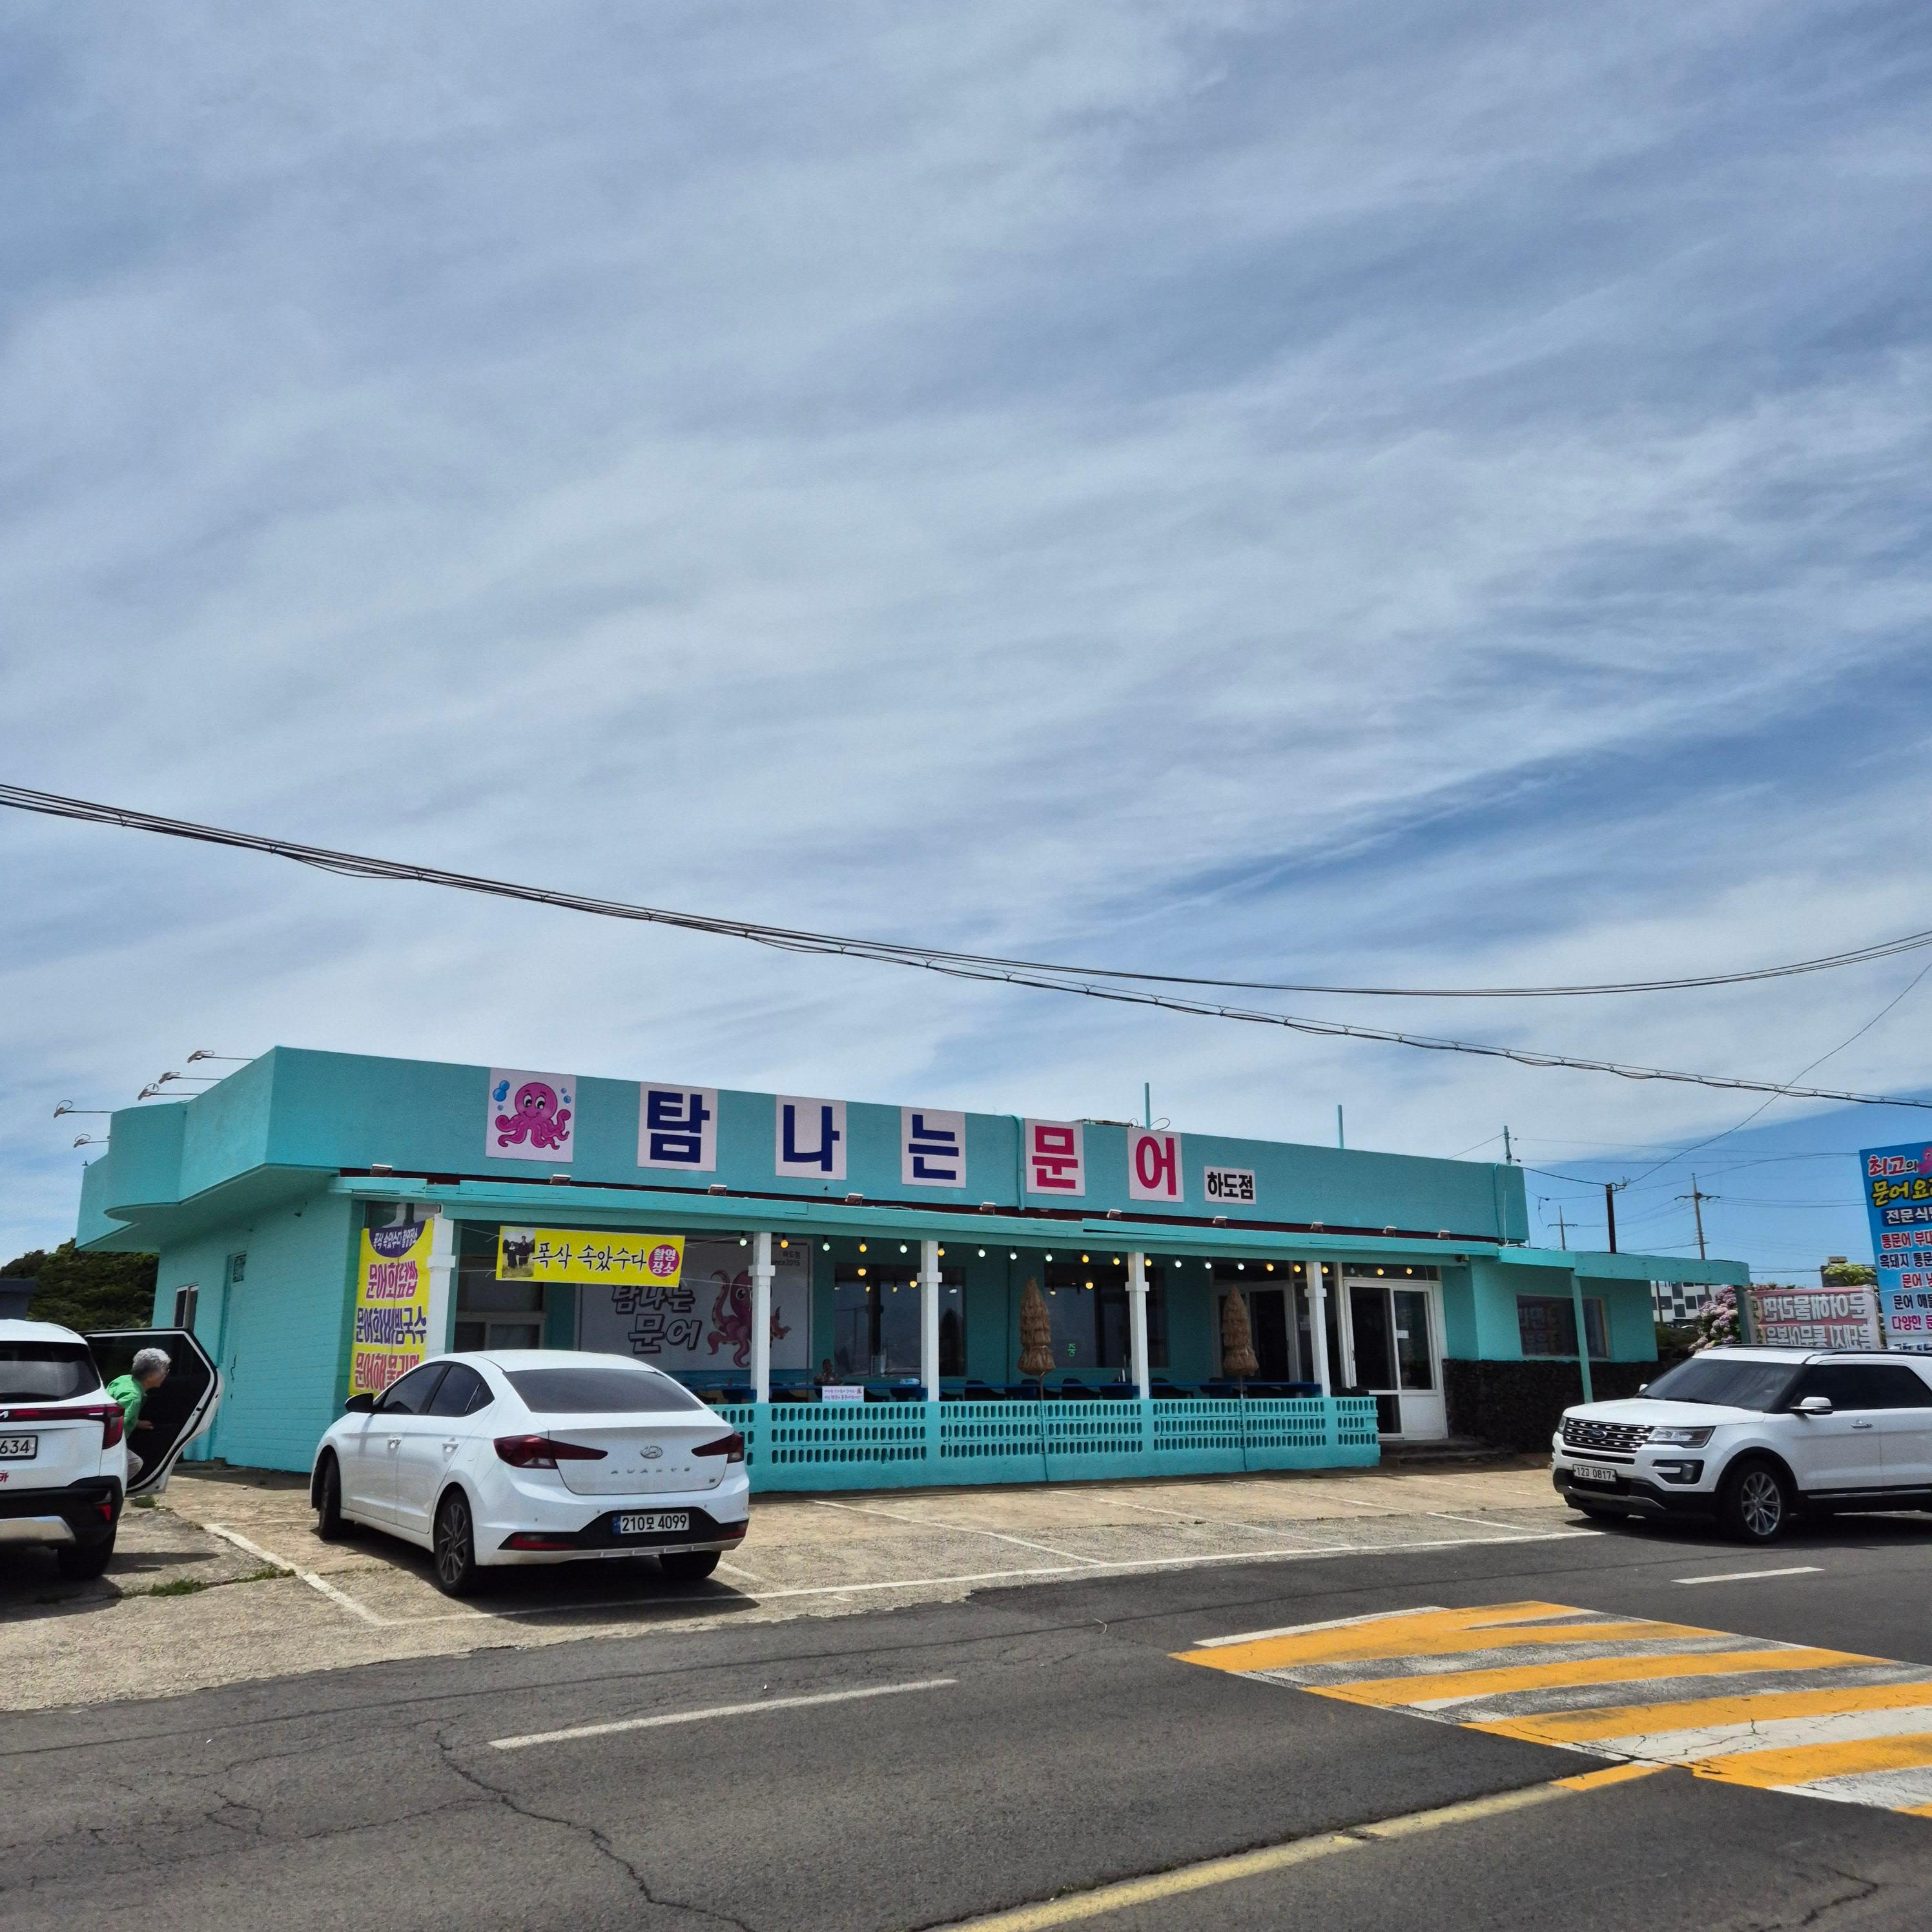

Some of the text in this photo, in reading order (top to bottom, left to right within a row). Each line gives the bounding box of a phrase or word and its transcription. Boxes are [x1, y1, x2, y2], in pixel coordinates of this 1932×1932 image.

[647, 1091, 1177, 1195] 탐나는 문어
[1869, 1155, 1918, 1177] 최고의
[1207, 1171, 1254, 1200] 하도점
[1873, 1179, 1909, 1206] 문어
[1881, 1231, 1912, 1249] 통문어
[577, 1244, 647, 1271] 속았수다
[653, 1248, 676, 1261] 촬영
[1879, 1253, 1909, 1268] 흑돼지
[652, 1261, 674, 1274] 장소
[365, 1260, 418, 1299] 문어회덮밥
[1902, 1273, 1922, 1288] 문어
[1893, 1293, 1914, 1310] 문어
[356, 1306, 427, 1345] 문어회비빔국수
[1891, 1315, 1922, 1330] 다양한
[628, 1313, 703, 1355] 문어
[1592, 1469, 1611, 1480] 0817
[622, 1515, 686, 1532] 210모 4099
